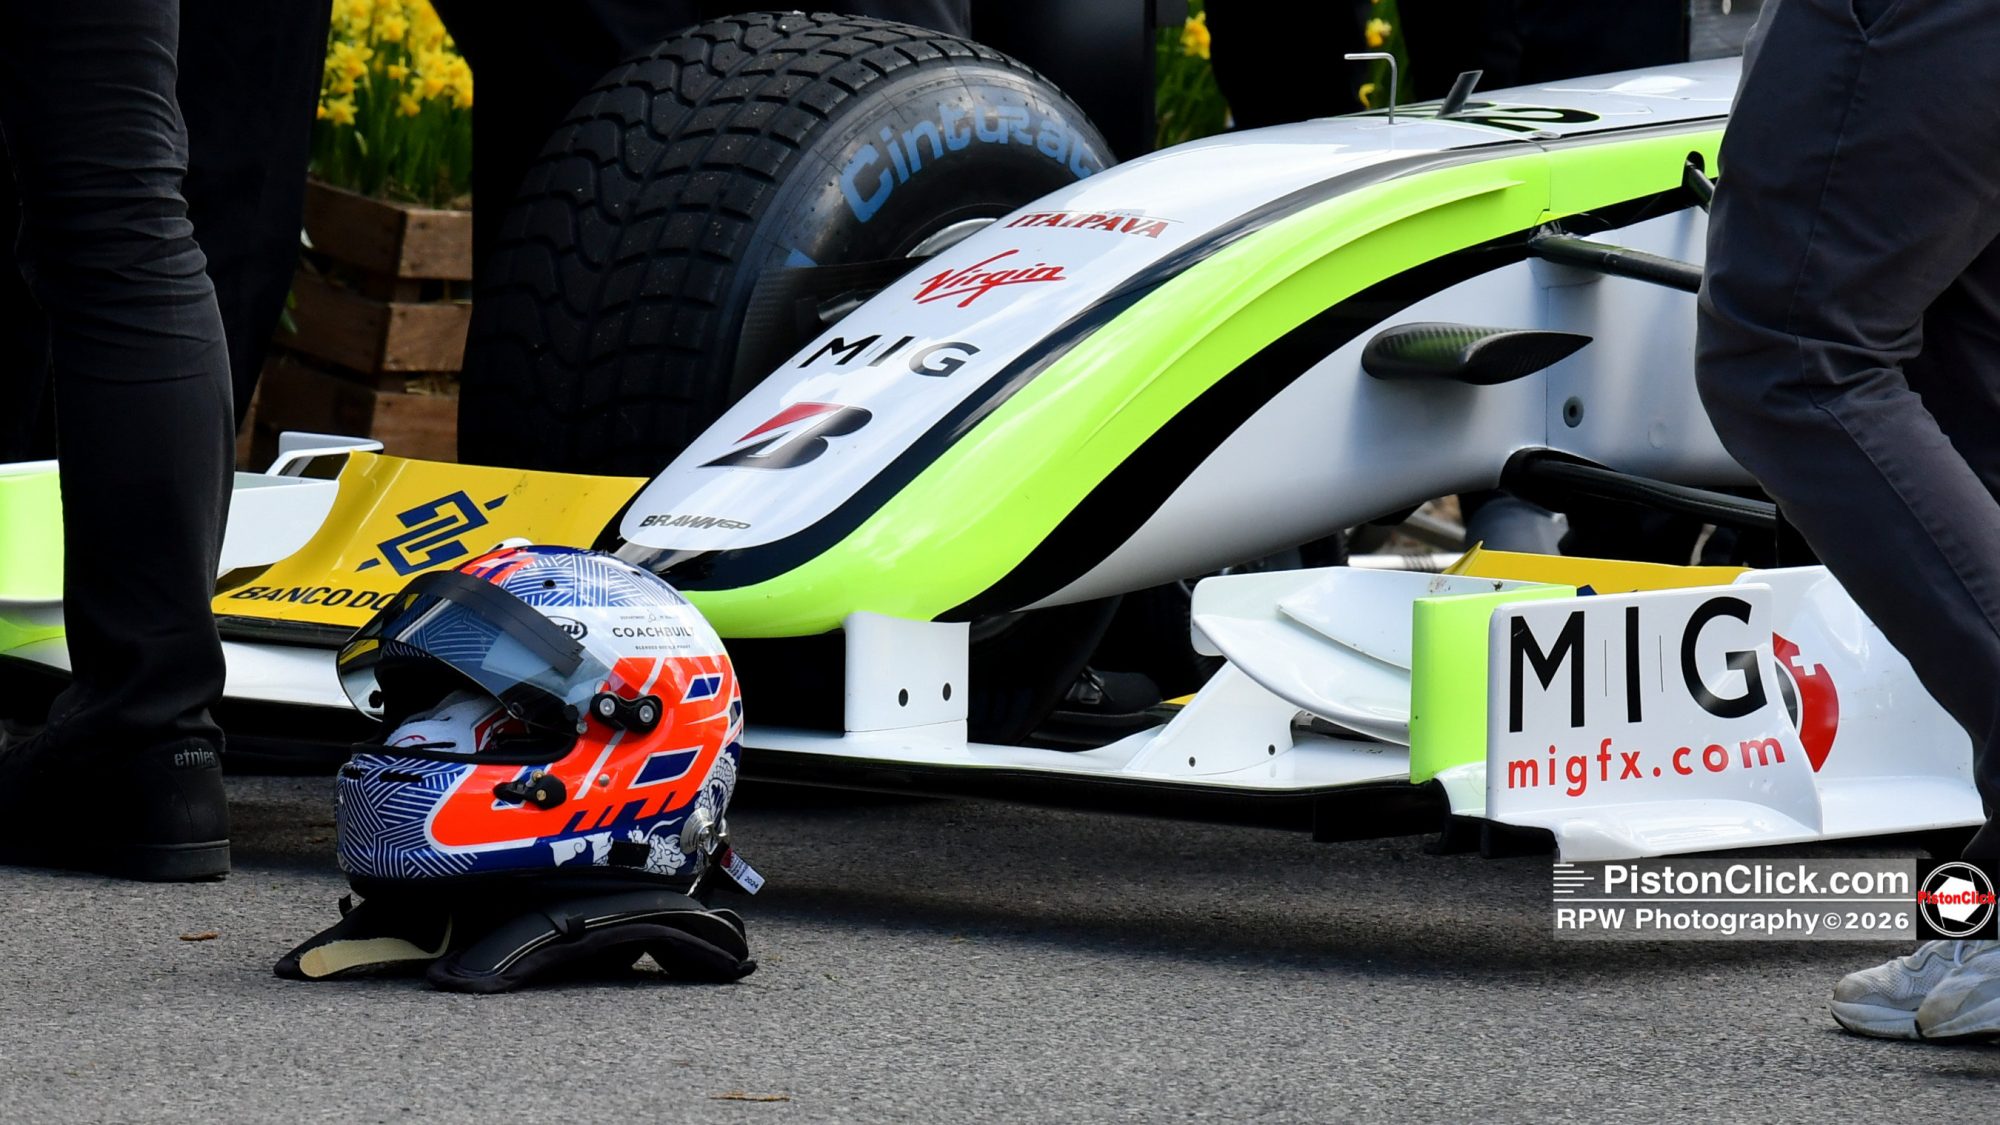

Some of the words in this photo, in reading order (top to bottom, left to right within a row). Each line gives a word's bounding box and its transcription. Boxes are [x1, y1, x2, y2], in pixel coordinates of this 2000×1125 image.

[1003, 212, 1169, 239] ITAIPAVA
[914, 249, 1067, 308] Virgin
[798, 334, 981, 378] MIG
[228, 586, 353, 607] BANCO
[612, 626, 695, 638] COACHBUIL
[1508, 596, 1768, 733] MIG
[174, 748, 216, 767] etnies
[1507, 737, 1786, 797] migfx.com
